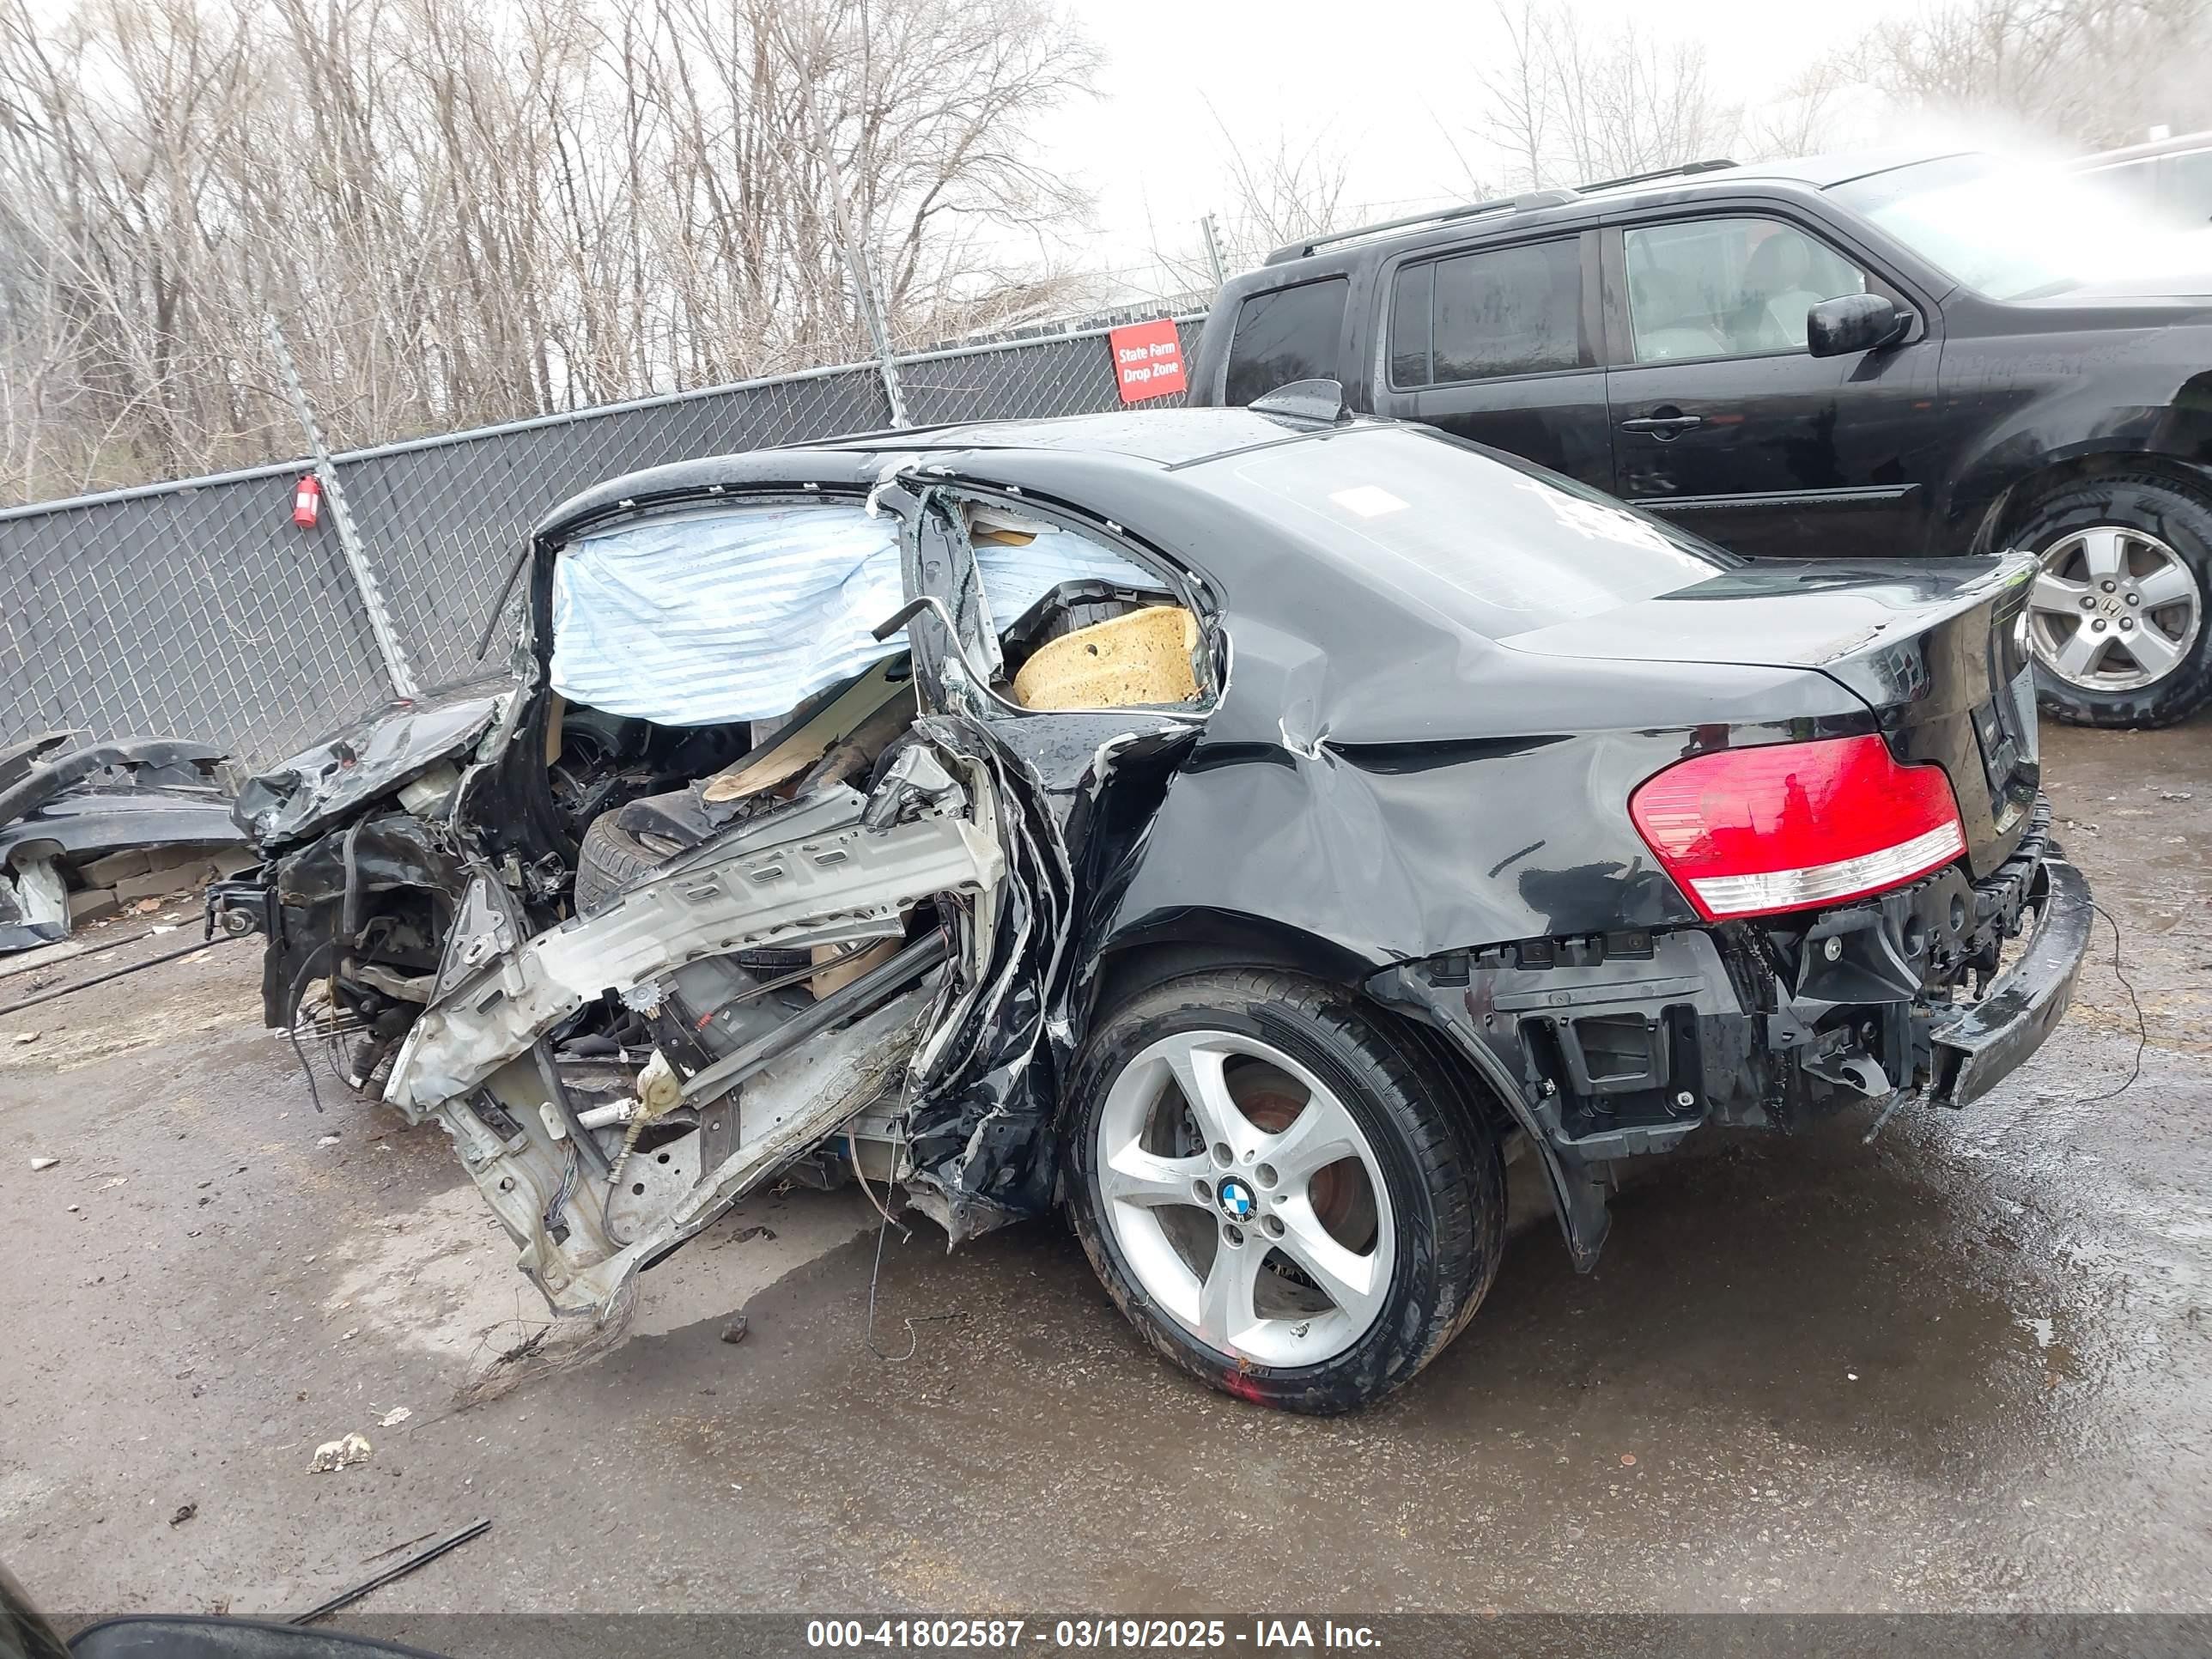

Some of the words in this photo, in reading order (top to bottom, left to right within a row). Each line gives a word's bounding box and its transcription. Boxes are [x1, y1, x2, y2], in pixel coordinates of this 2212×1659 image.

[1119, 347, 1148, 363] State
[1150, 343, 1176, 357] Farm
[1123, 368, 1151, 383] Drop
[1152, 362, 1179, 377] Zone
